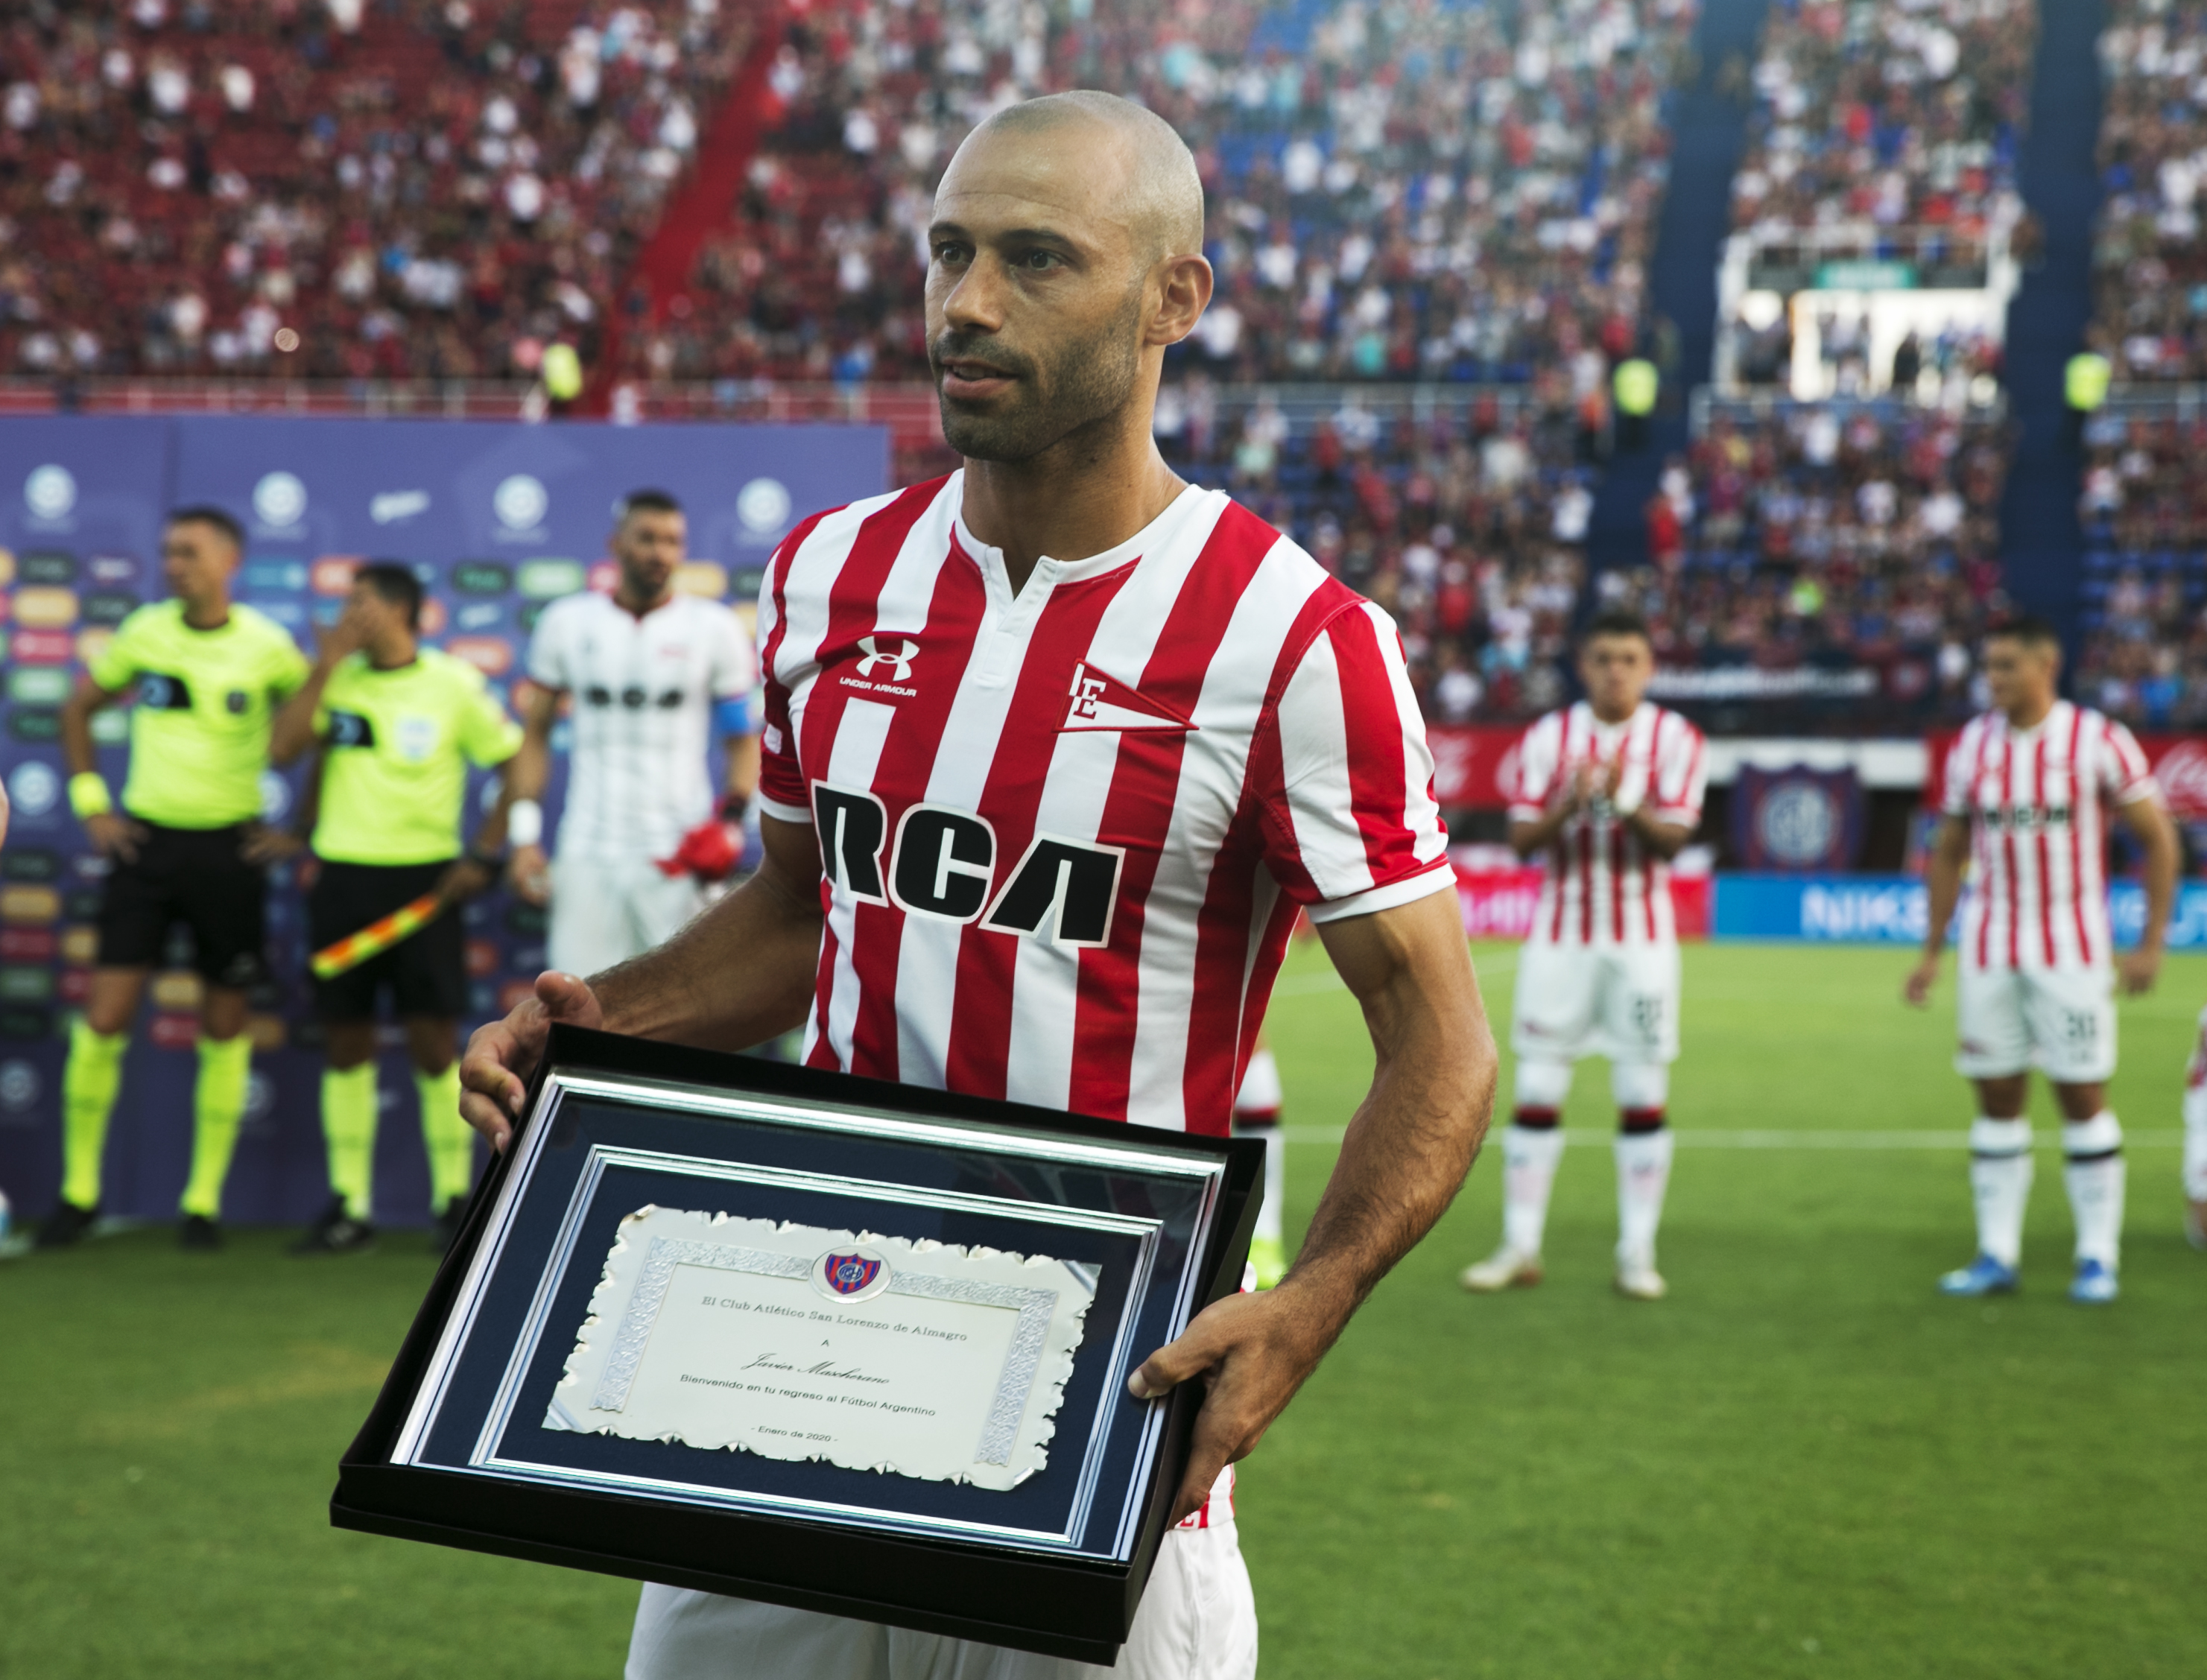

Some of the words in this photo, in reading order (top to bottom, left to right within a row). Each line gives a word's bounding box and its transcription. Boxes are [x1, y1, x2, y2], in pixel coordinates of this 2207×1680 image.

[839, 676, 873, 690] UNDER
[873, 683, 917, 697] ARMOUR
[811, 779, 1126, 948] RCA
[701, 1296, 717, 1306] El
[720, 1299, 751, 1310] Club
[753, 1304, 805, 1319] Atlético
[808, 1310, 832, 1322] San
[835, 1314, 890, 1330] Lorenzo
[893, 1323, 908, 1333] de
[911, 1325, 967, 1342] Almagro
[820, 1339, 830, 1347] A
[741, 1352, 794, 1370] Javier
[797, 1360, 890, 1384] Mascherano
[680, 1374, 744, 1389] Bienvenido
[747, 1384, 761, 1392] en
[764, 1386, 776, 1395] tu
[779, 1389, 824, 1401] regreso
[826, 1395, 837, 1403] al
[840, 1395, 878, 1408] Fútbol
[879, 1401, 936, 1417] Argentino
[758, 1425, 788, 1436] Enero
[790, 1430, 804, 1439] de
[805, 1432, 832, 1442] 2020
